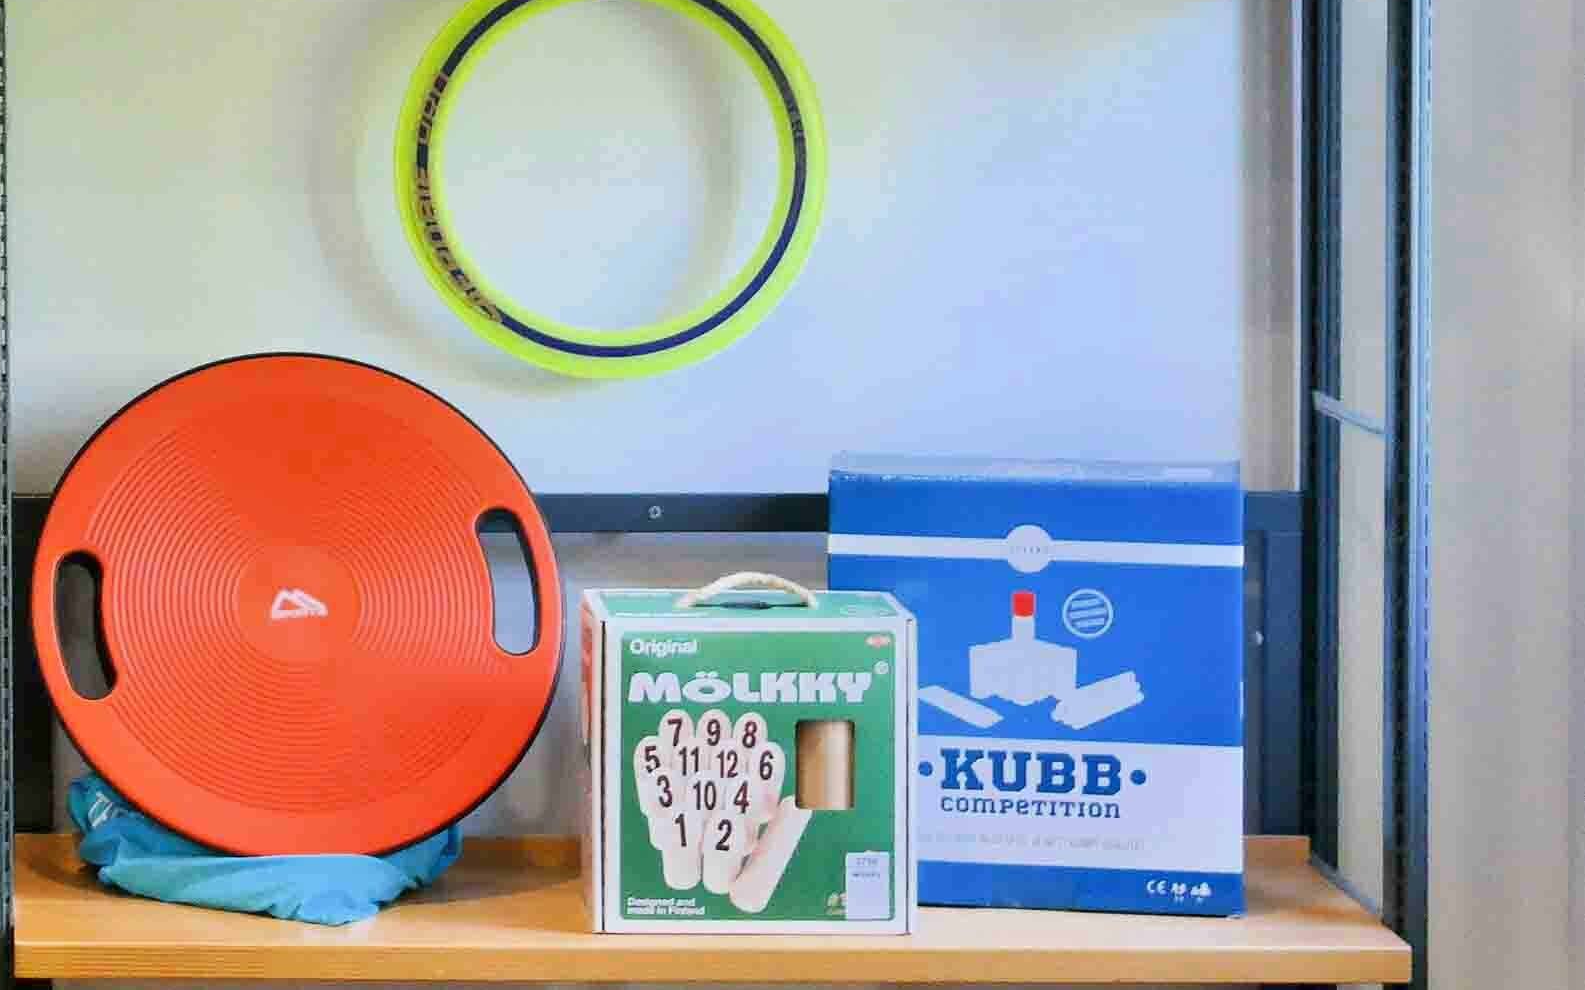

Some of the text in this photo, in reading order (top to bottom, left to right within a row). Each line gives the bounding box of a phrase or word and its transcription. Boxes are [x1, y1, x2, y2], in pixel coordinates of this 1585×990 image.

[629, 639, 698, 658] Original
[627, 670, 873, 703] MÖLKKY
[667, 718, 757, 749] 7 9 8
[644, 745, 774, 781] 5 11 12 6
[940, 748, 1121, 796] KUBB
[656, 775, 749, 814] 3 10 4
[674, 813, 732, 852] 1 2
[676, 897, 696, 907] and
